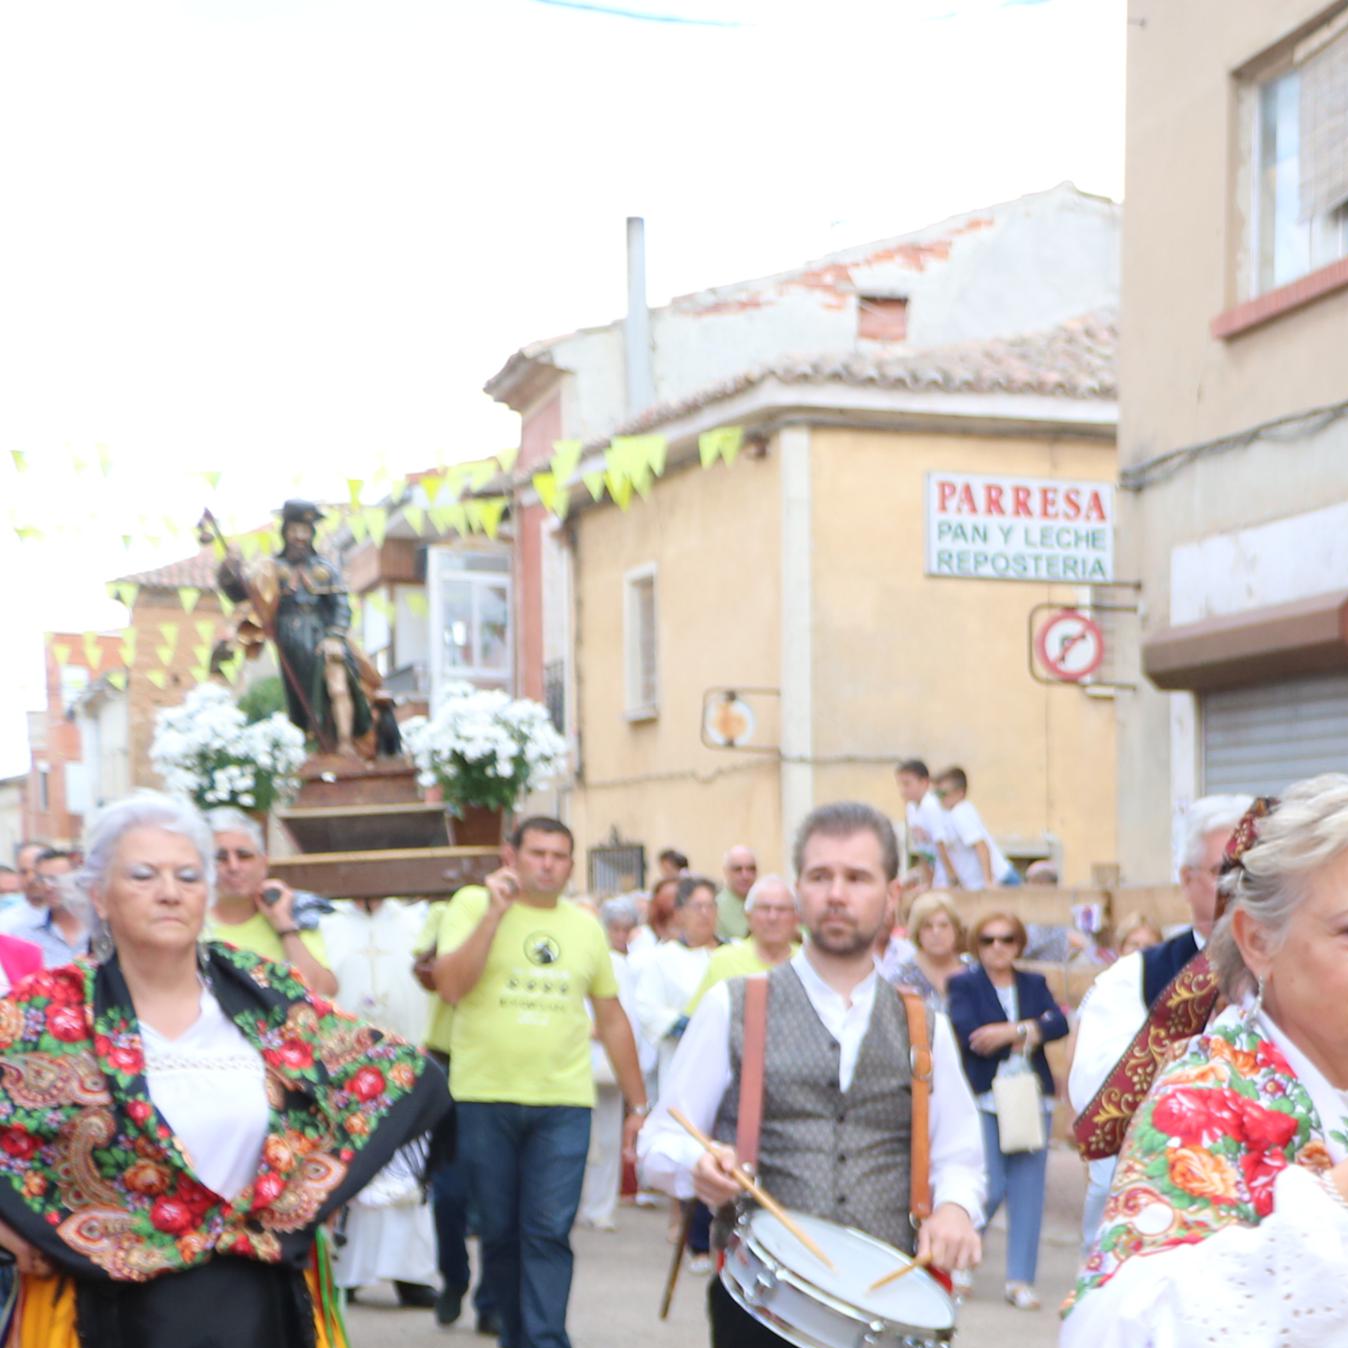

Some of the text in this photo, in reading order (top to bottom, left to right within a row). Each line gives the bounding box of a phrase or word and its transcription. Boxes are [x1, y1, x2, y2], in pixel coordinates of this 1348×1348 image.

[937, 481, 1106, 521] PARRESA
[938, 522, 1106, 550] PAN Y LECHE
[937, 550, 1107, 579] REPOSTERIA
